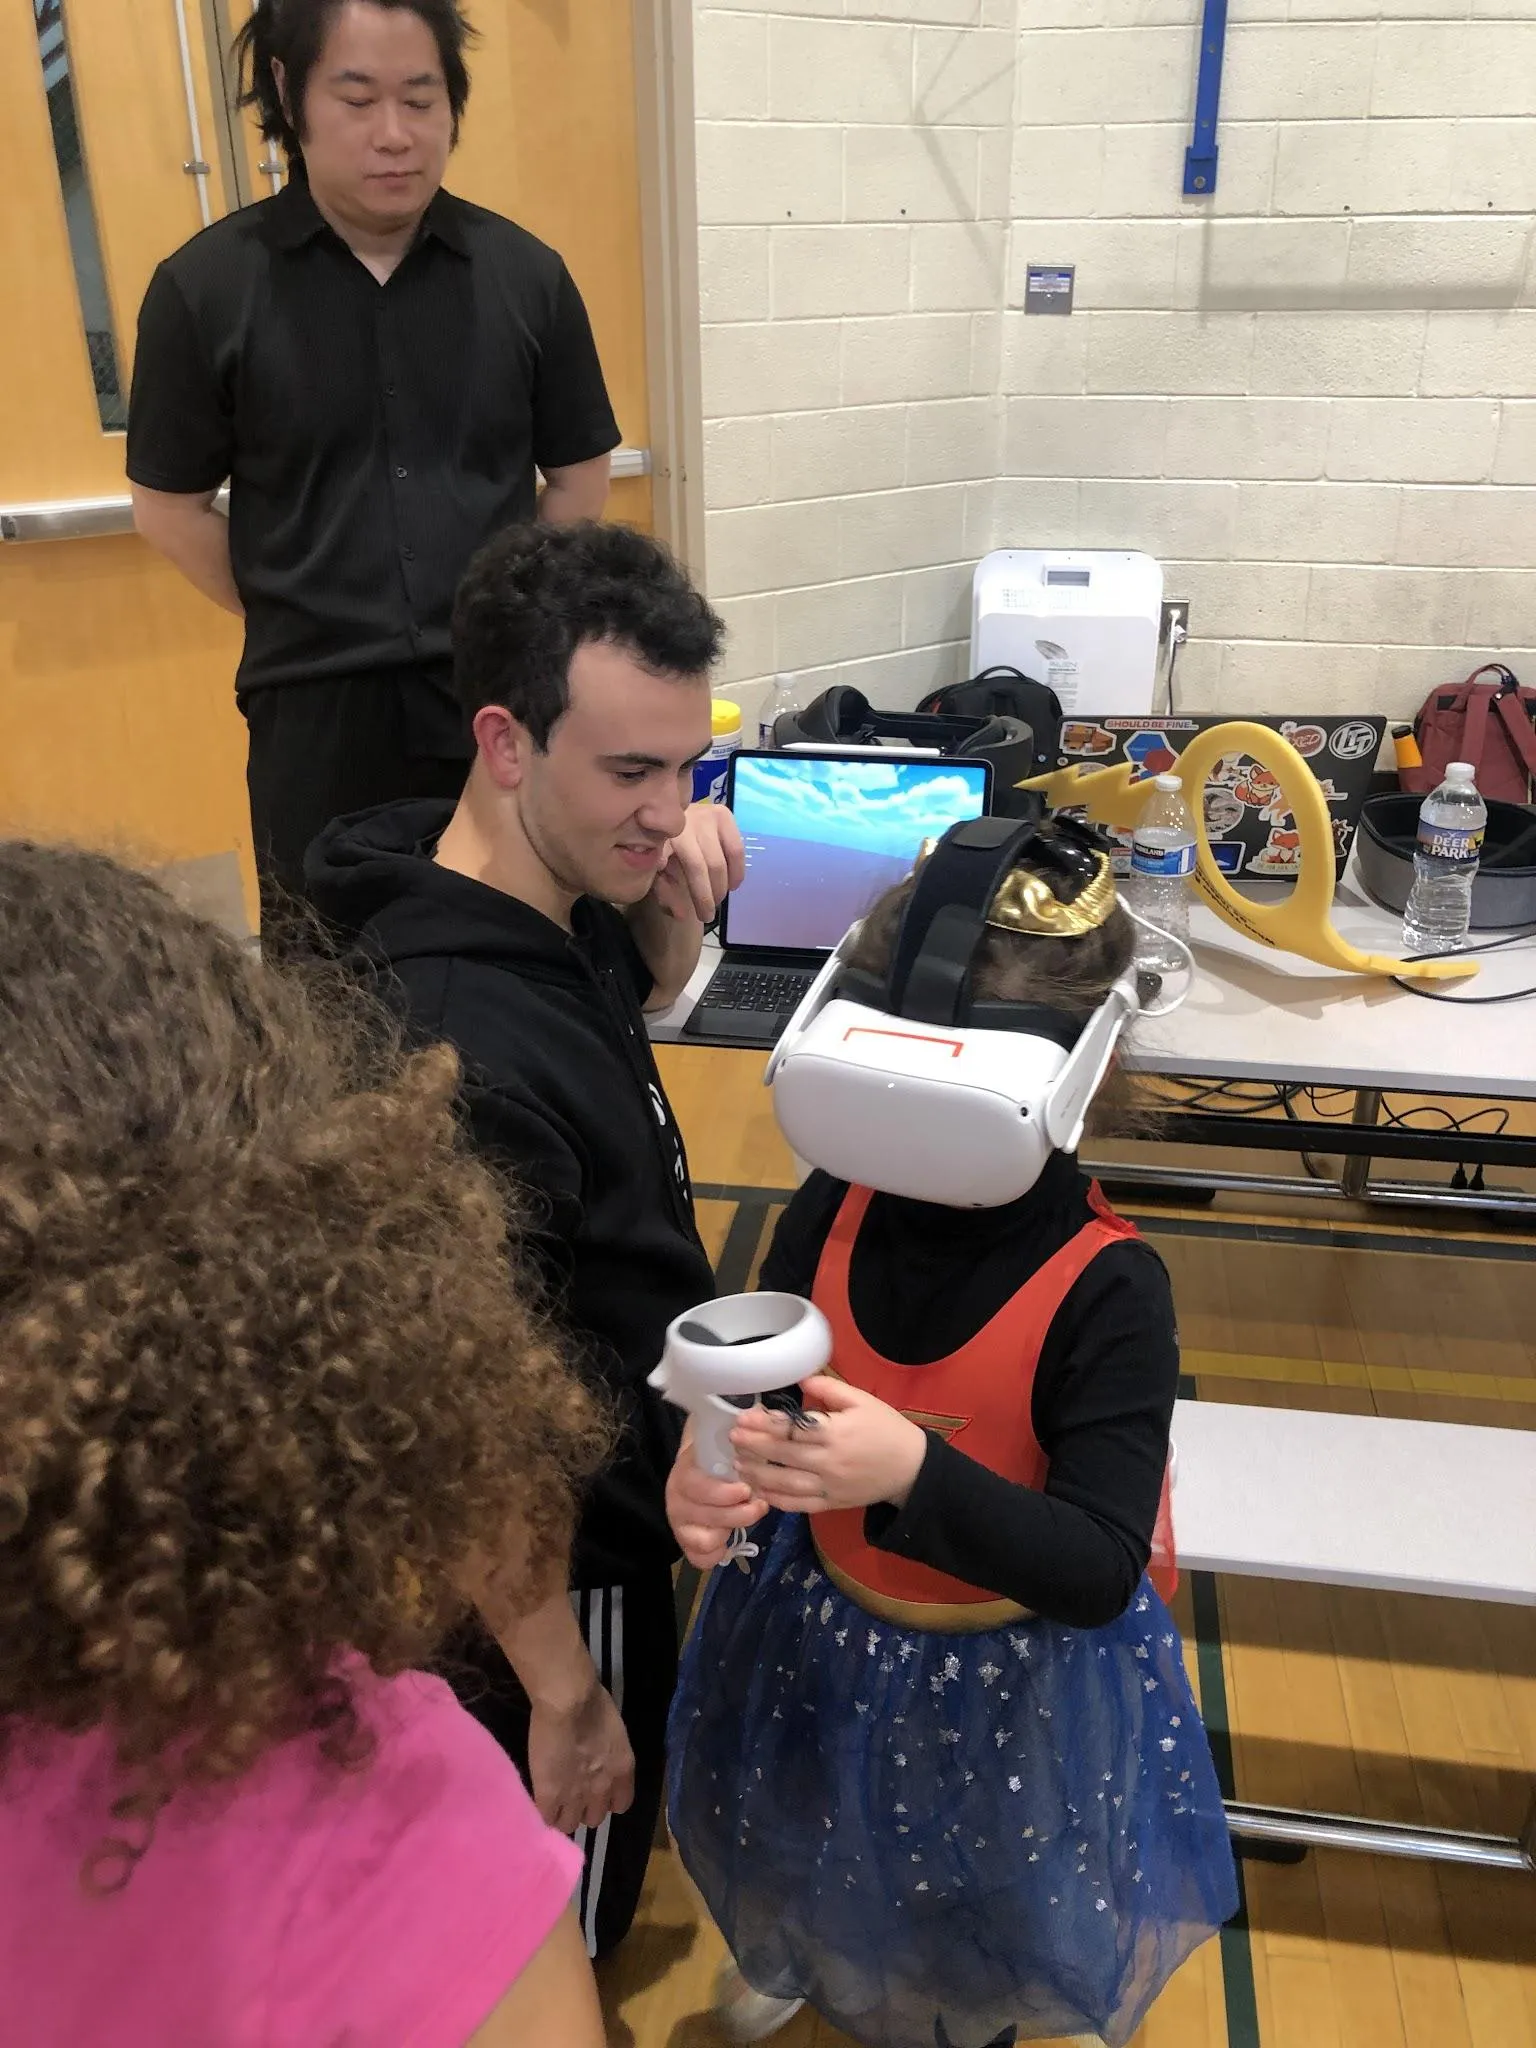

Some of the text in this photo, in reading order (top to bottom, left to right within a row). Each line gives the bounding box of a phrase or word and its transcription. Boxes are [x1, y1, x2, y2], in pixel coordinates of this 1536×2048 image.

[1106, 719, 1150, 729] SHOULD
[1151, 720, 1165, 729] BE
[1433, 834, 1470, 849] DEER
[1431, 845, 1469, 860] PARK
